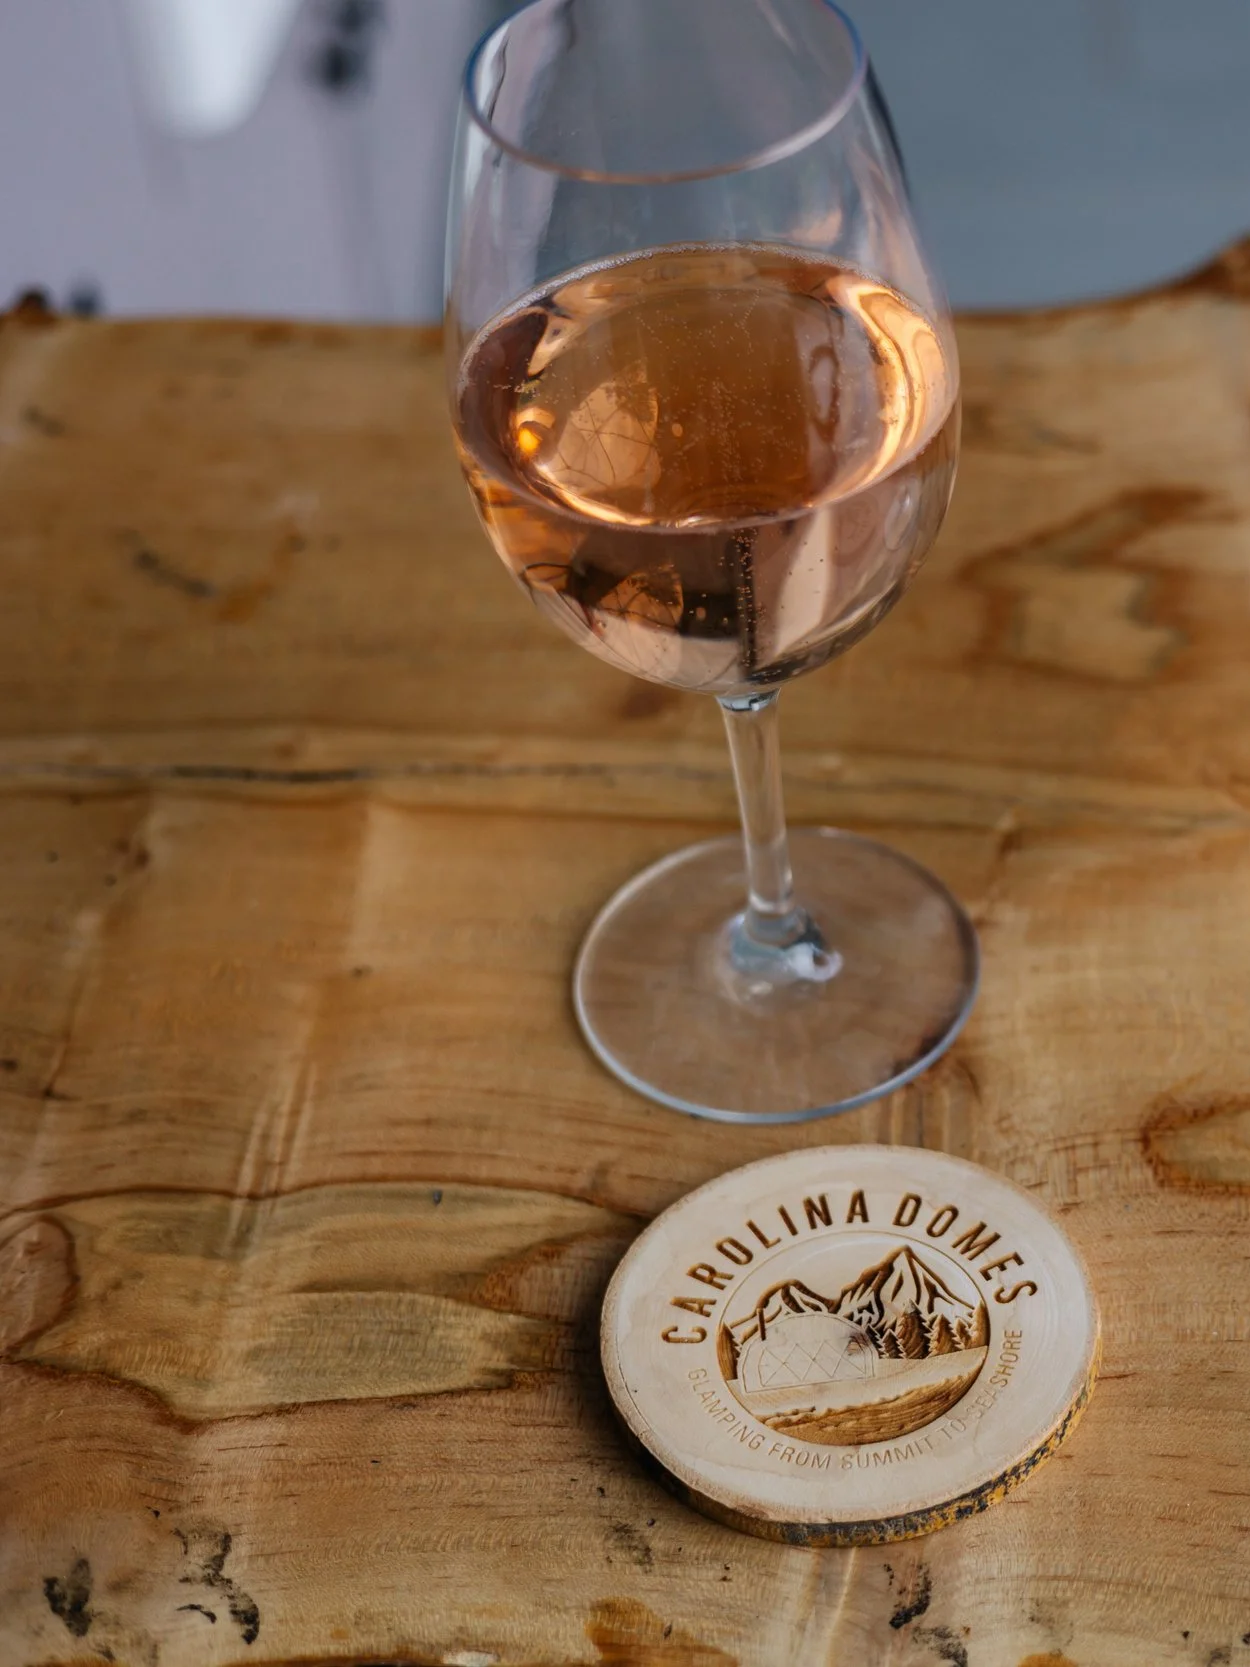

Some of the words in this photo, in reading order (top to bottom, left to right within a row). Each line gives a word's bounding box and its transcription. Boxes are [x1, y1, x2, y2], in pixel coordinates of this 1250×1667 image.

[660, 1188, 870, 1344] CAROLINA
[892, 1191, 1038, 1304] DOMES
[687, 1367, 766, 1451] GLAMPING
[768, 1442, 831, 1471] FROM
[840, 1433, 934, 1471] SUMMIT
[939, 1416, 967, 1441] TO
